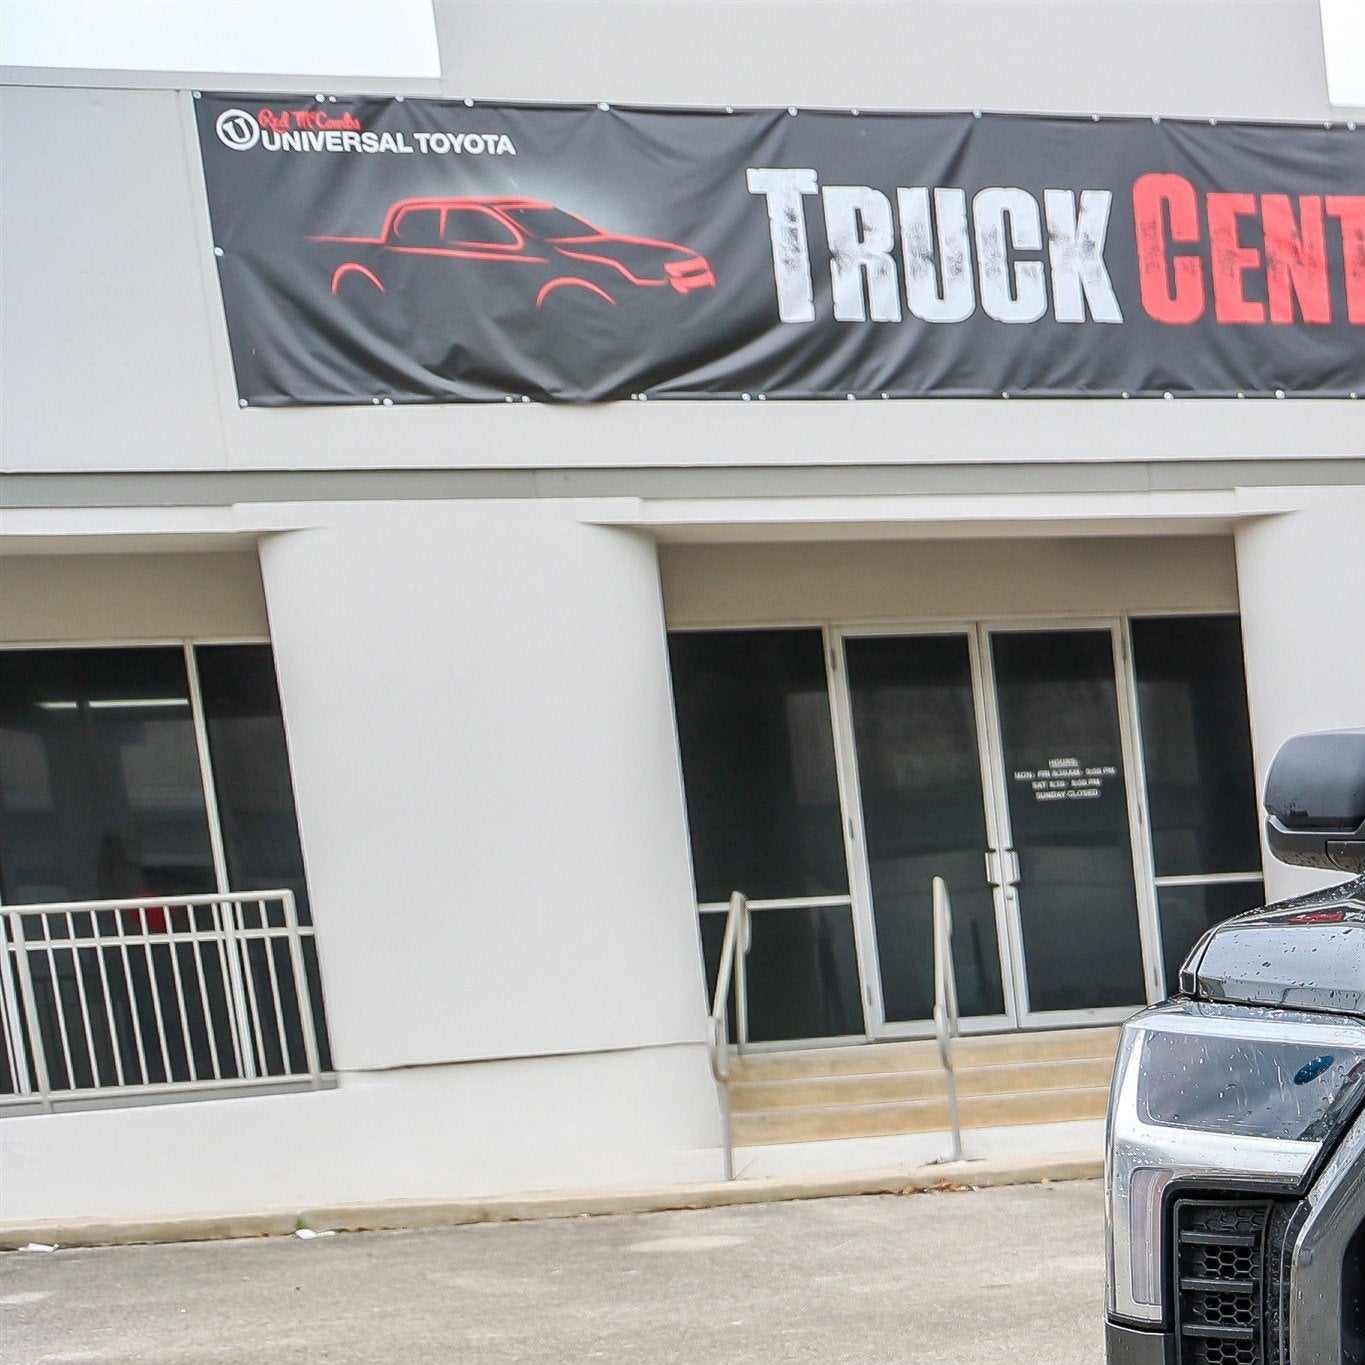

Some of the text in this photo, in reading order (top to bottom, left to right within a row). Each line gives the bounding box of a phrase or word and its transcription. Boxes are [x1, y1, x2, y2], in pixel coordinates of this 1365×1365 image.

[257, 108, 290, 133] Red
[261, 129, 517, 156] UNIVERSAL TOYOTA
[745, 167, 1123, 325] TRUCK
[1035, 788, 1099, 800] SUNDAY CLOSED
